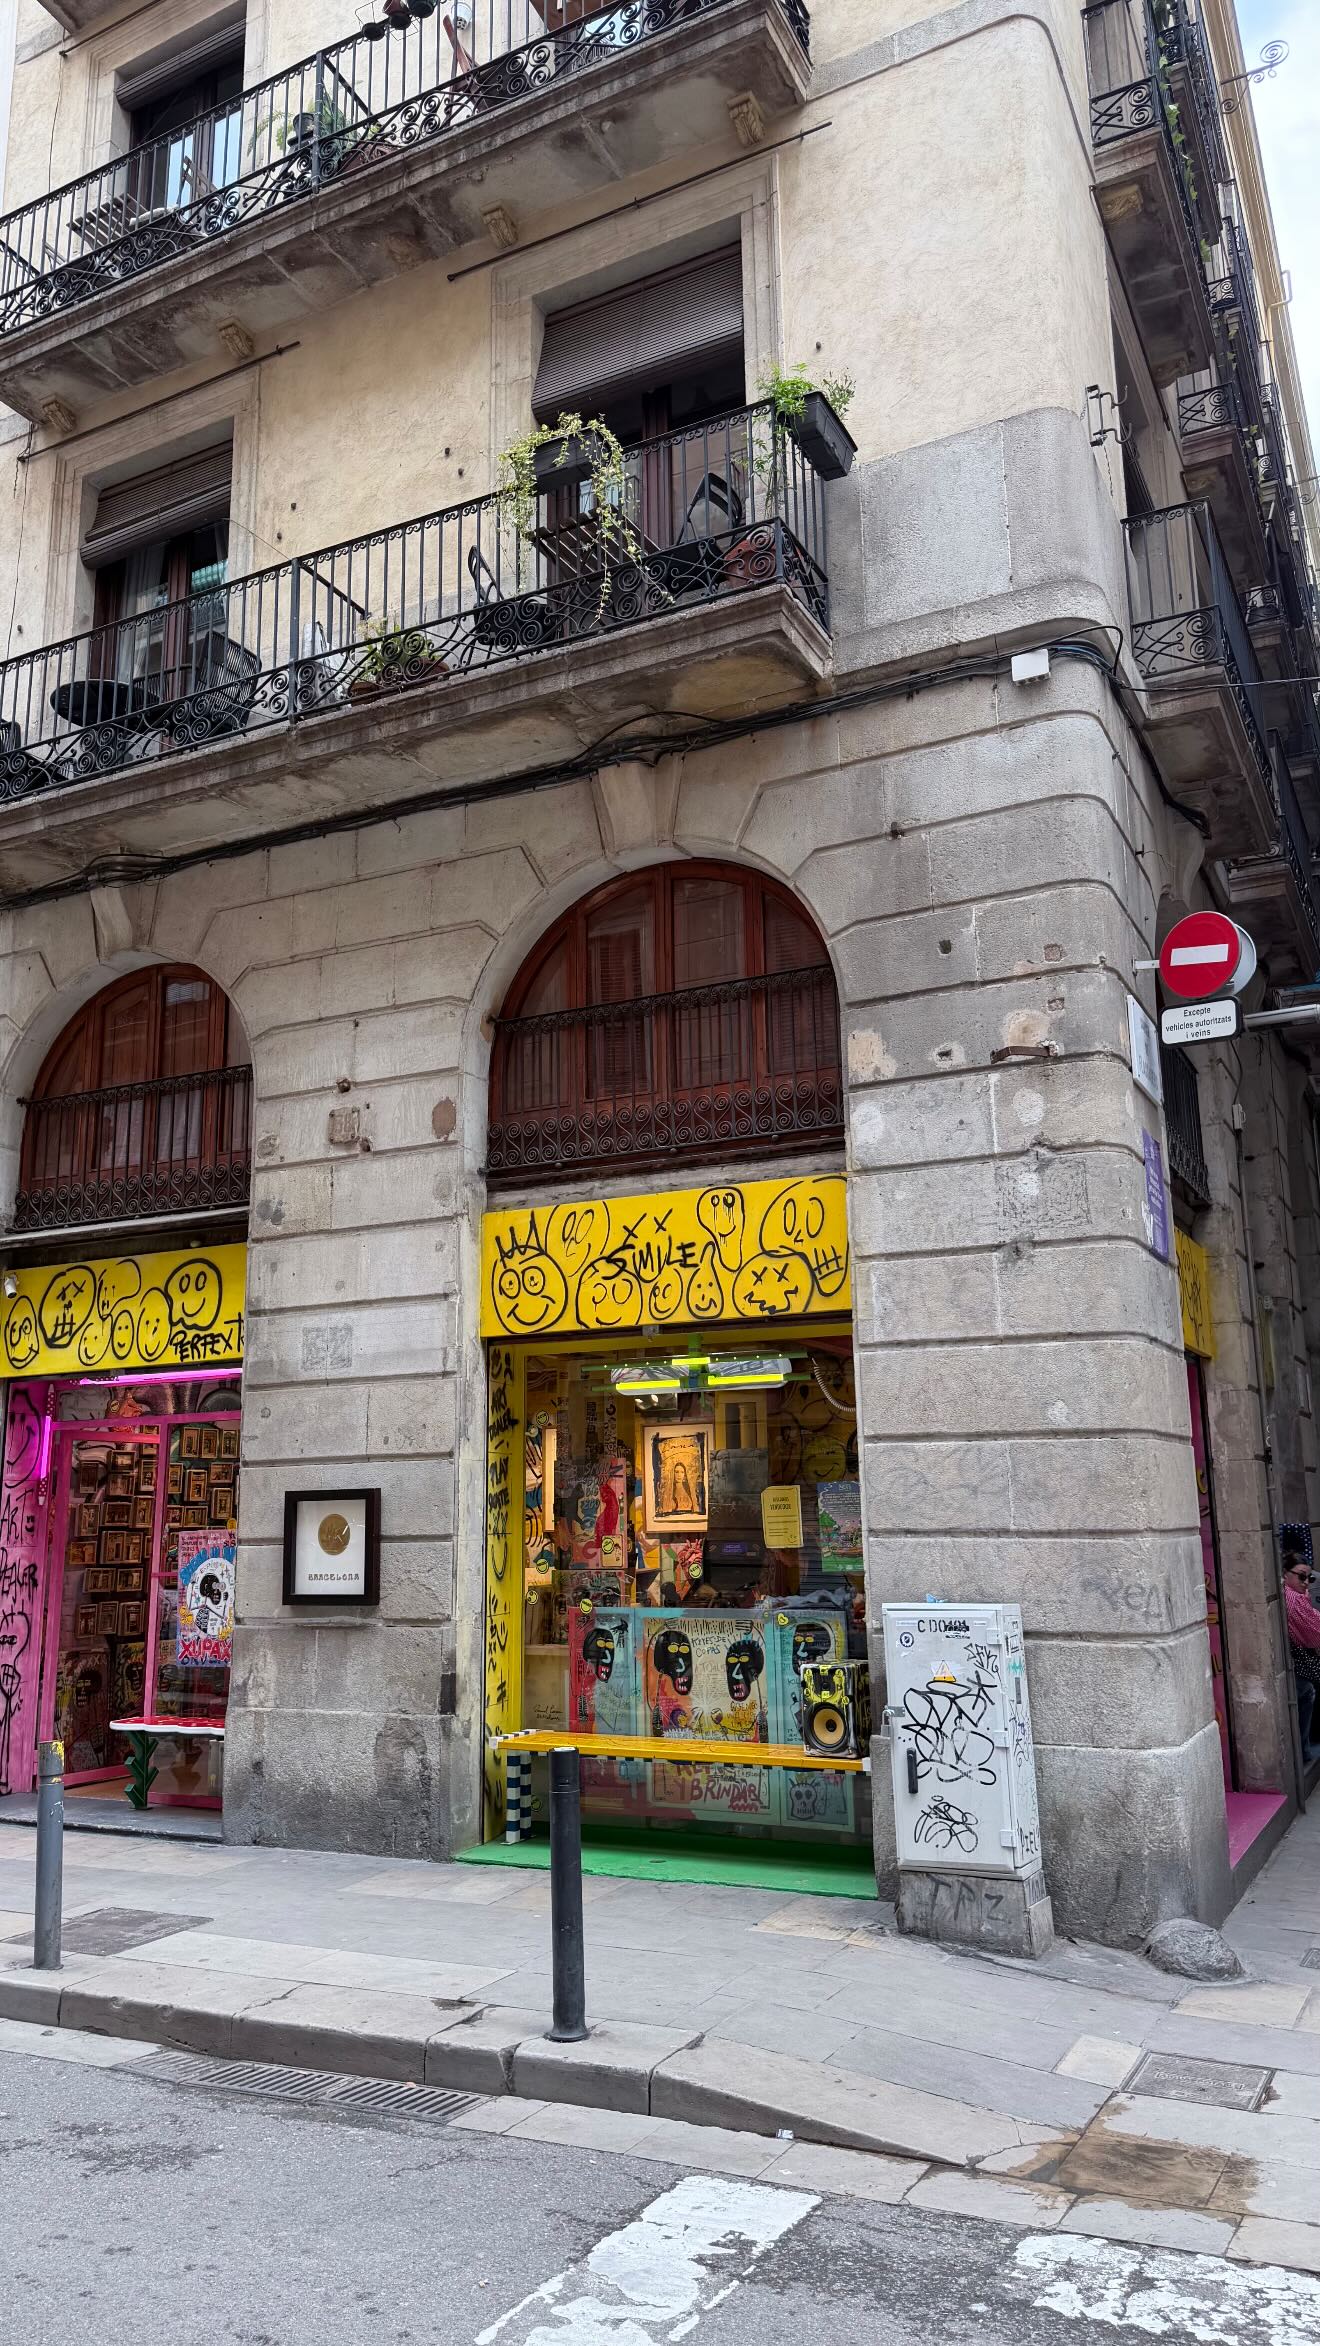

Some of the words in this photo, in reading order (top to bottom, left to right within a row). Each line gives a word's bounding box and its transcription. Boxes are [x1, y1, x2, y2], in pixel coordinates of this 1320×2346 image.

[1183, 1007, 1211, 1017] Excepte
[1165, 1021, 1194, 1032] vehicles
[1195, 1015, 1232, 1028] autoritzats
[602, 1235, 699, 1280] SMILE
[1, 1488, 34, 1545] ART
[308, 1573, 360, 1581] BARCELONA
